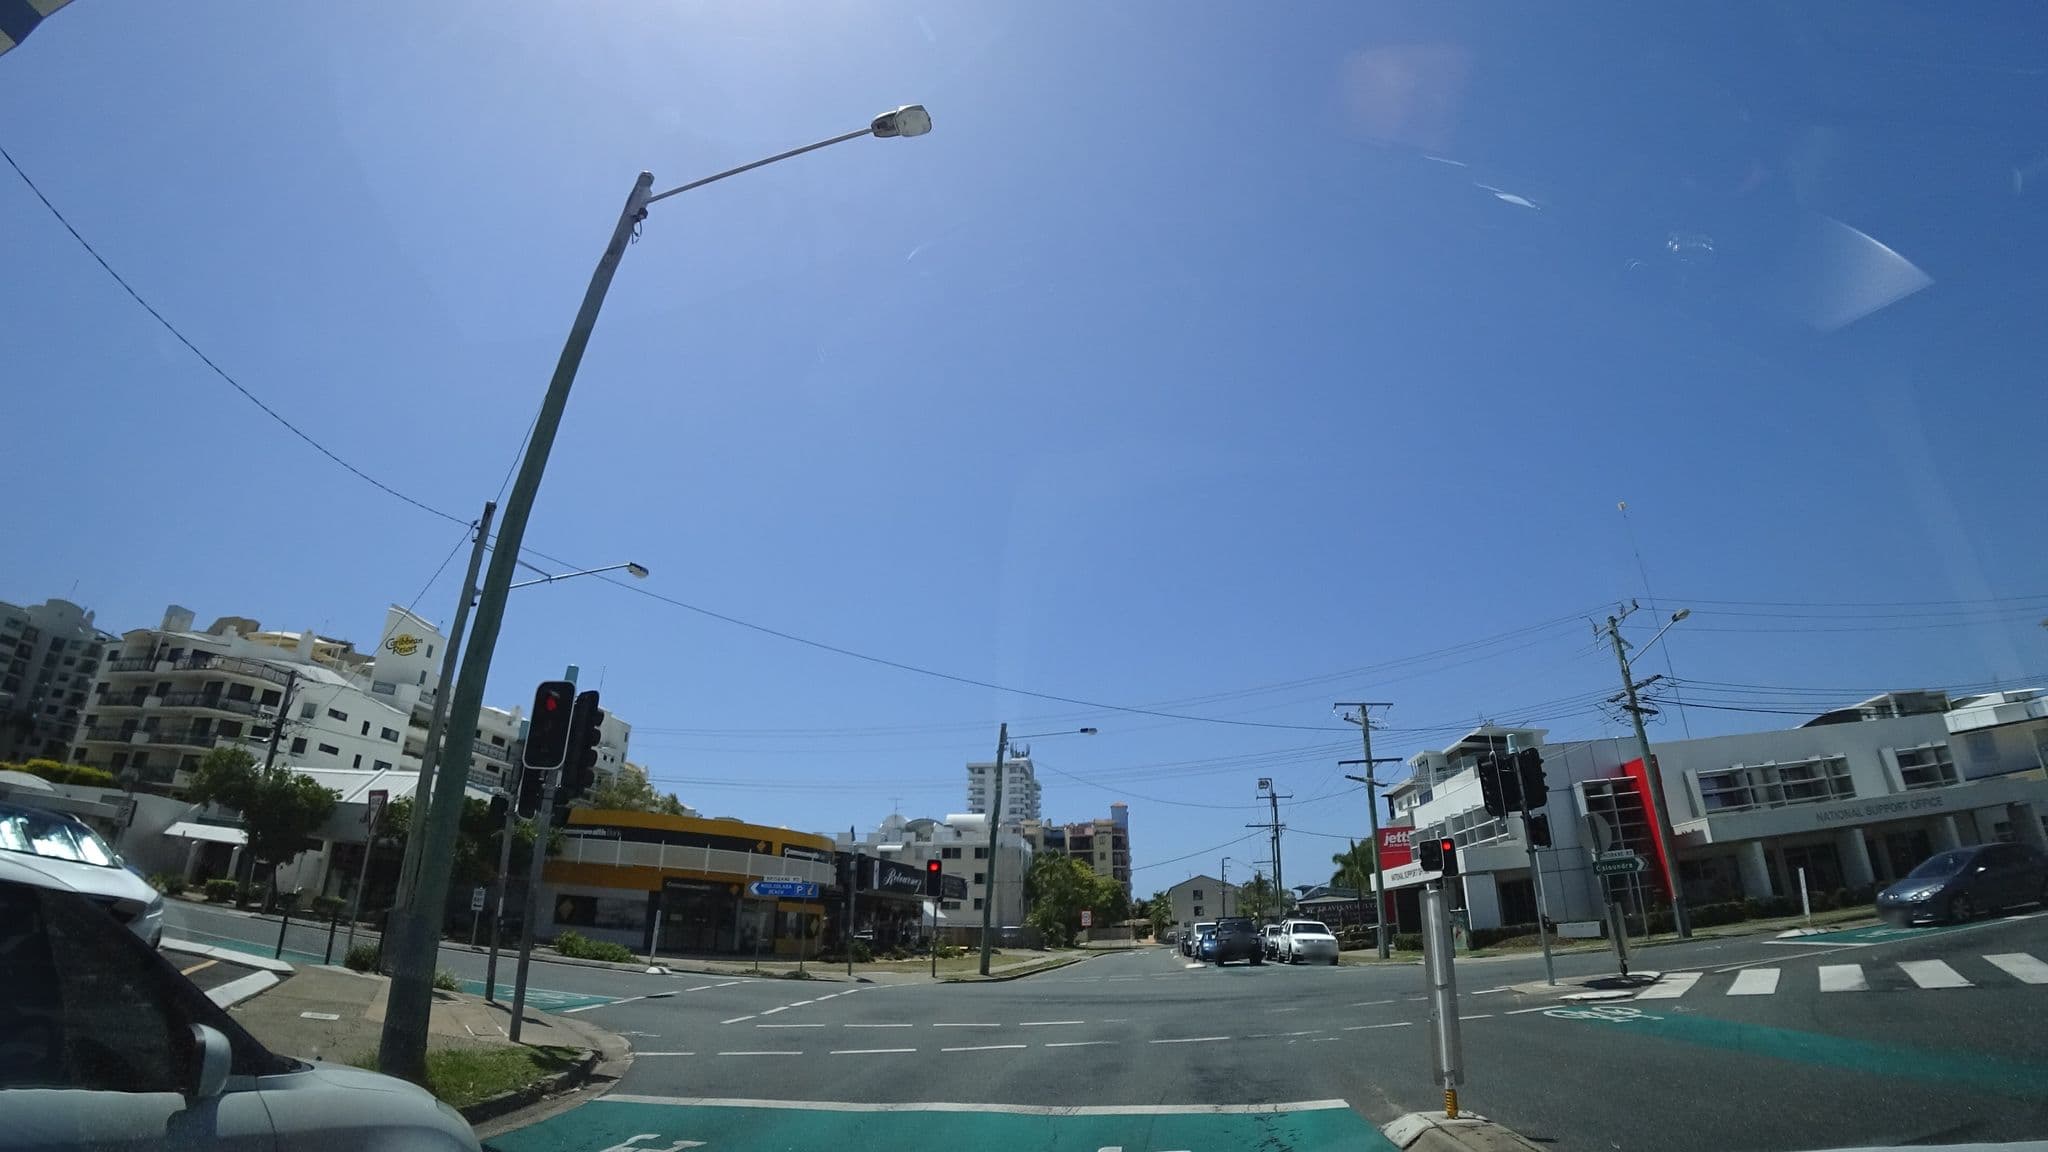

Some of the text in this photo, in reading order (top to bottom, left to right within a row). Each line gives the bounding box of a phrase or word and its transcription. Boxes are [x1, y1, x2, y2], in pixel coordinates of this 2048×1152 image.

[385, 636, 423, 650] Caribbean
[392, 644, 417, 656] Resort
[1816, 796, 1943, 823] NATIONAL SUPPORT OFFICE
